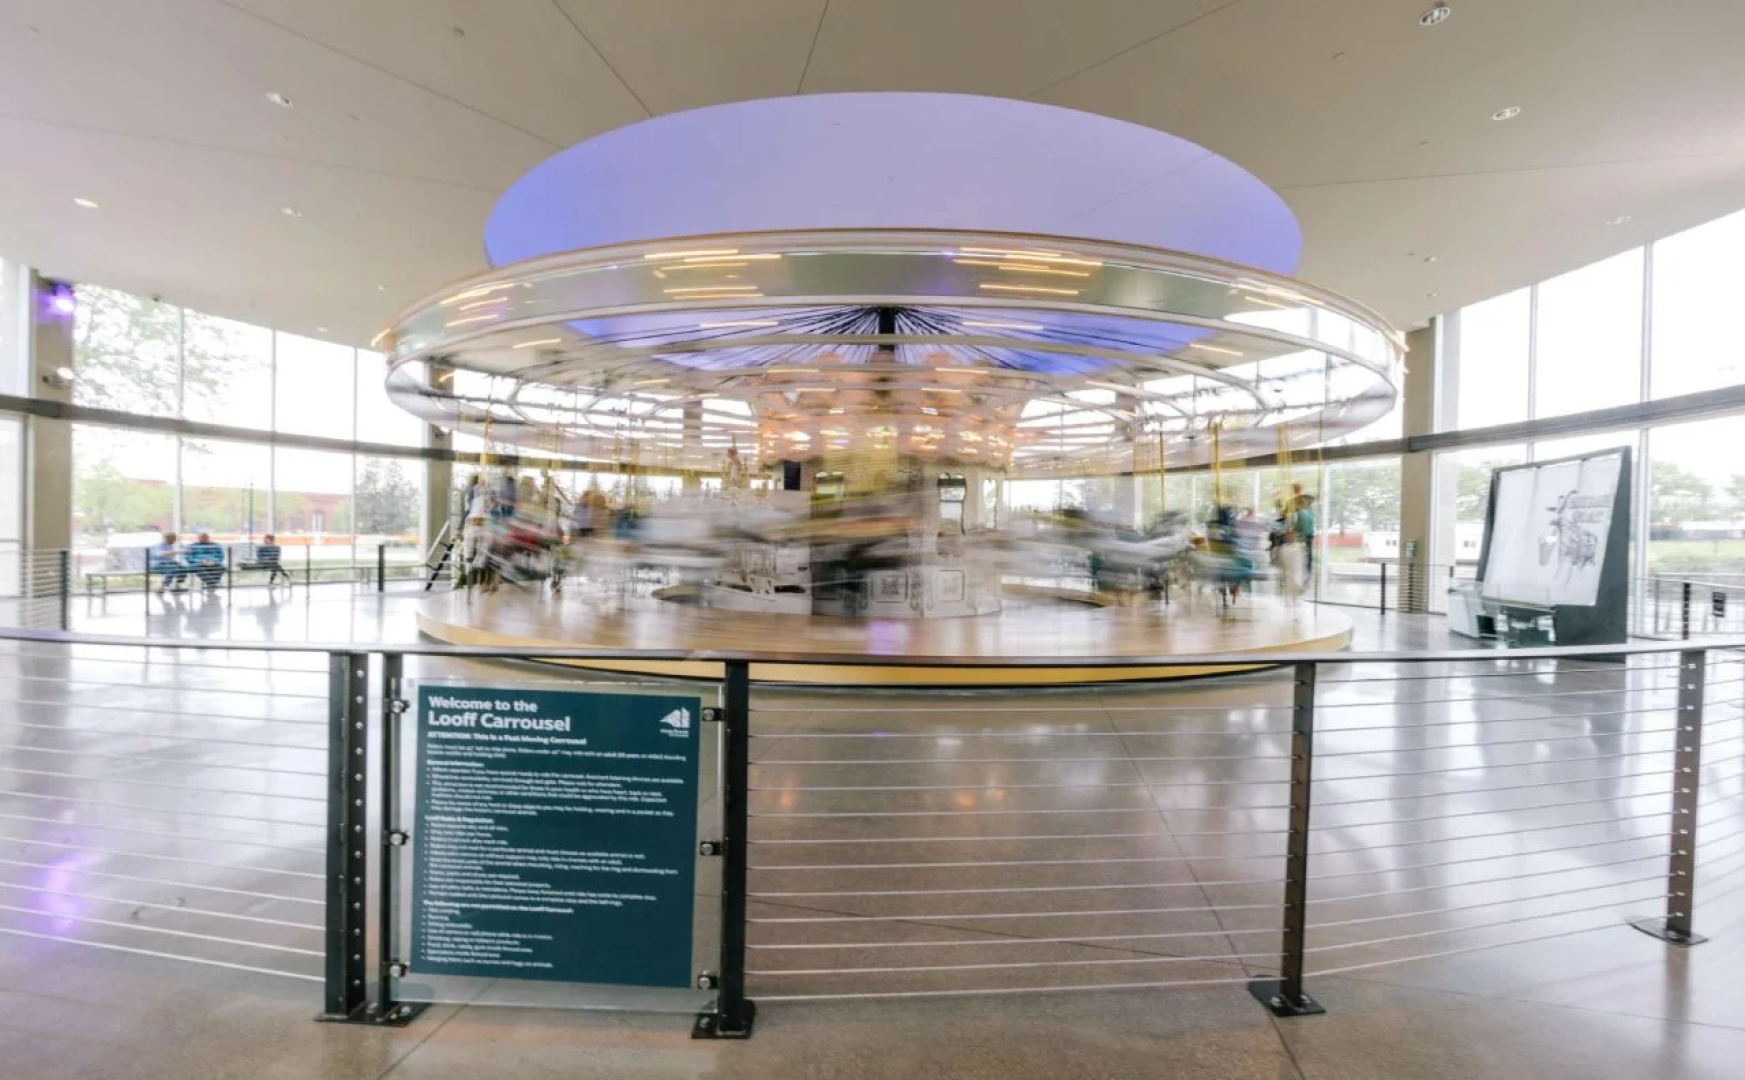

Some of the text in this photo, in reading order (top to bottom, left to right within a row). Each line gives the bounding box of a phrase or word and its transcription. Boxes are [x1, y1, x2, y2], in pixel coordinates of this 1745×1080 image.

[428, 696, 538, 713] Welcome to the
[428, 711, 571, 732] Looff Carrousel
[473, 732, 489, 741] This
[489, 733, 497, 741] is
[504, 734, 520, 742] Fast
[521, 735, 549, 745] Moving
[550, 737, 587, 746] Carrousel
